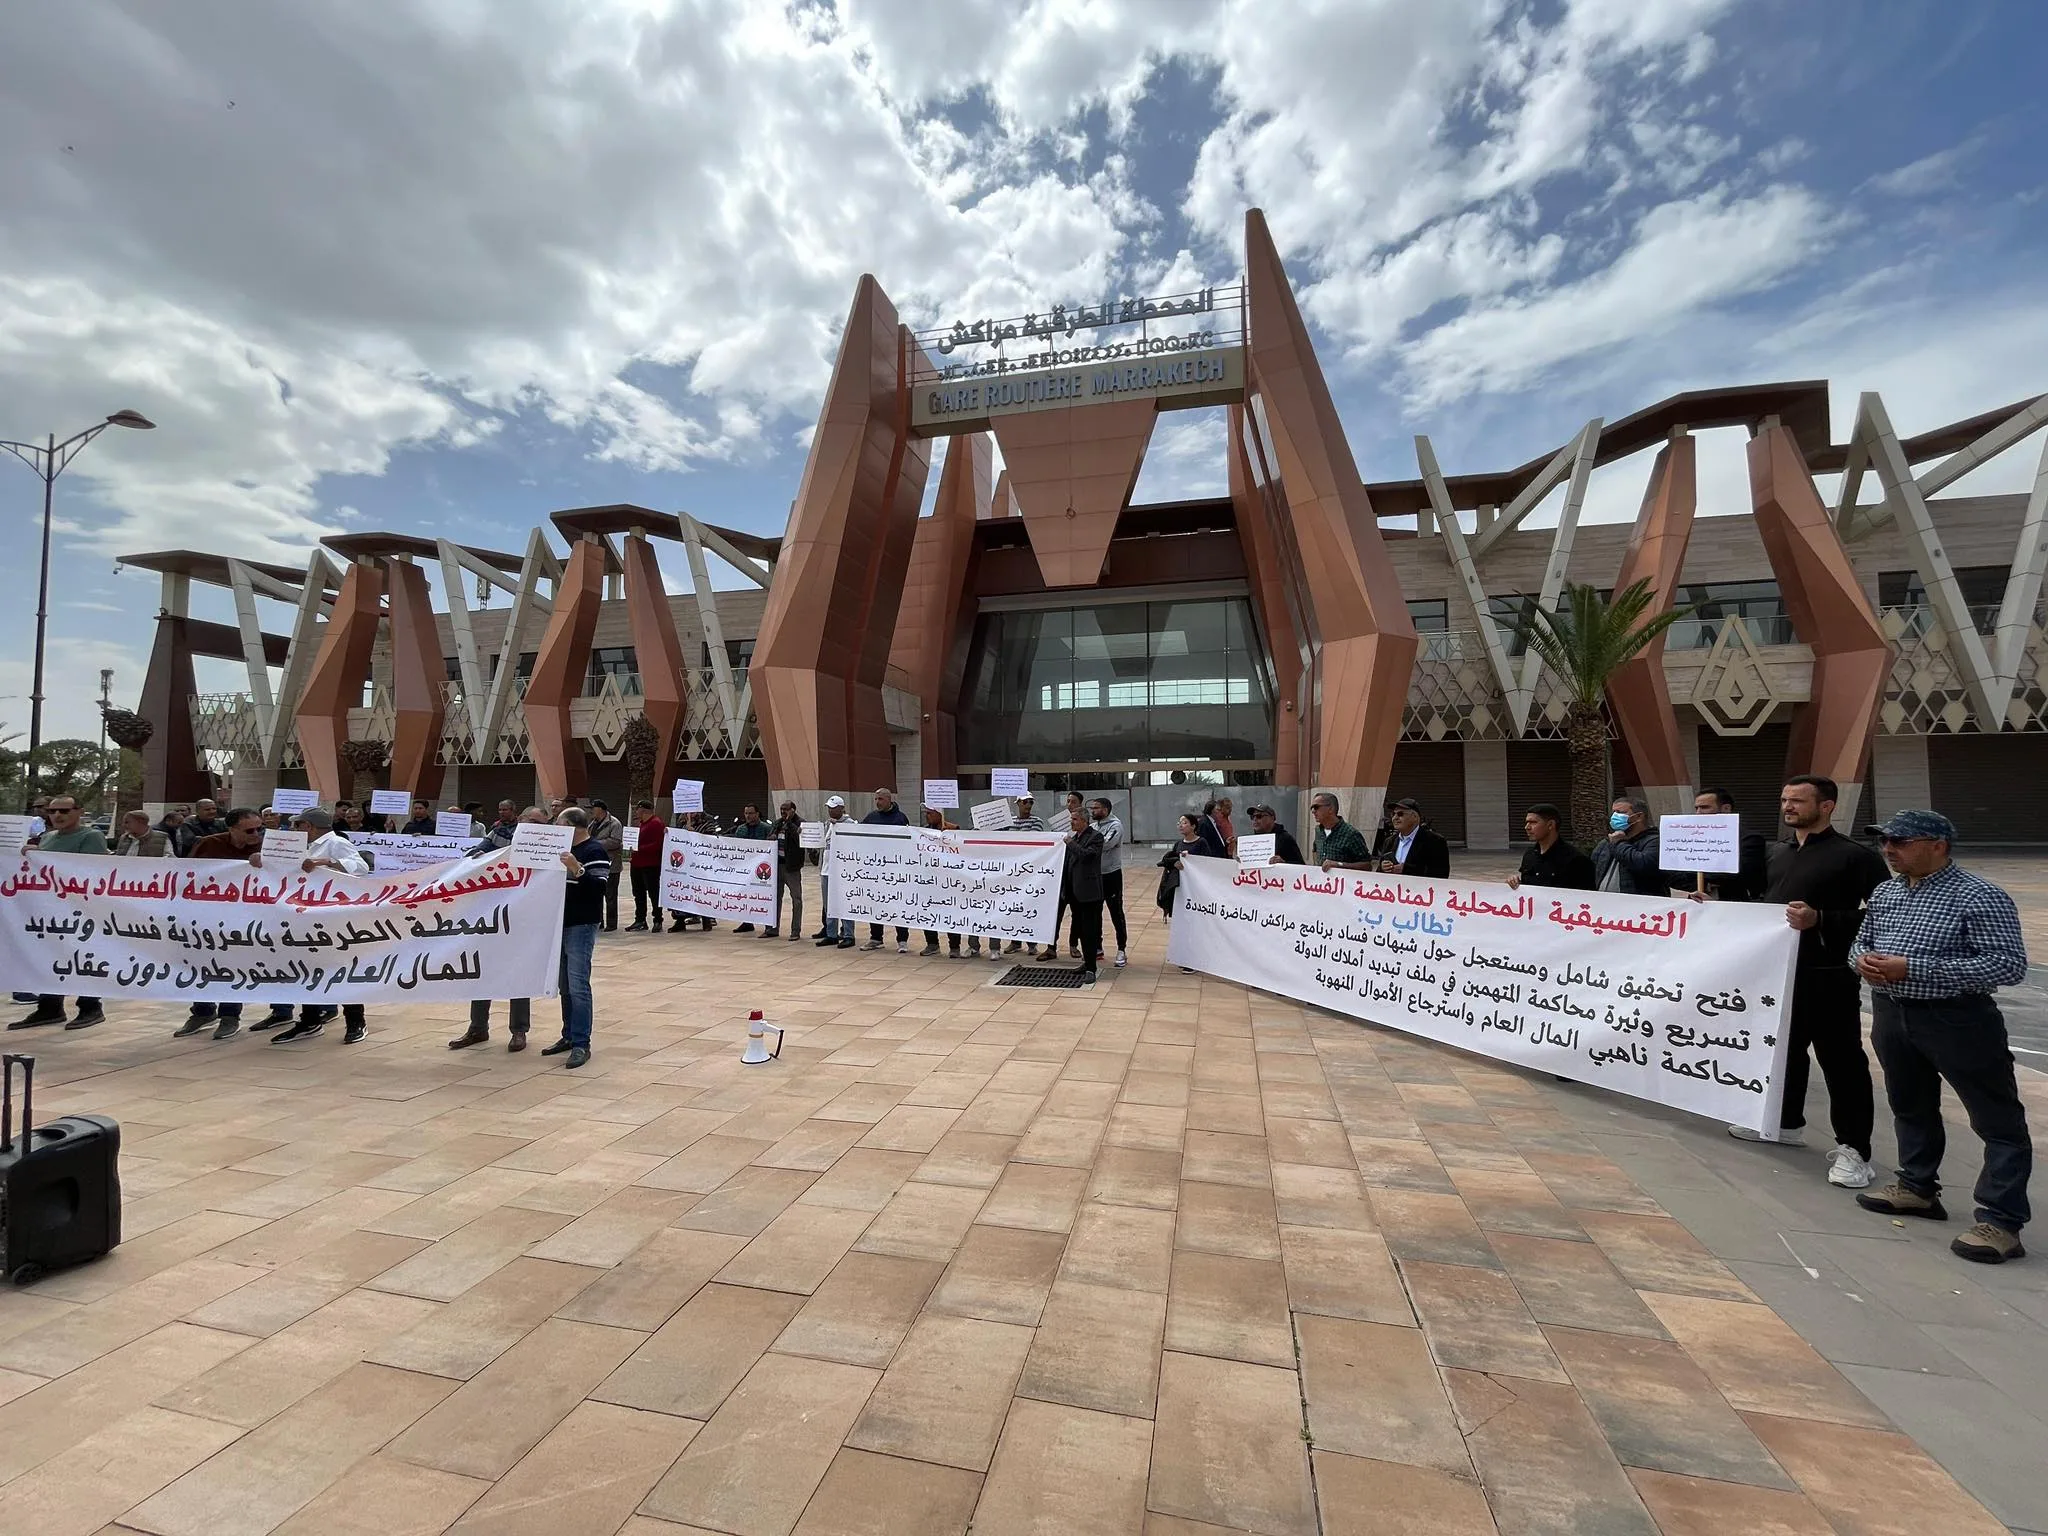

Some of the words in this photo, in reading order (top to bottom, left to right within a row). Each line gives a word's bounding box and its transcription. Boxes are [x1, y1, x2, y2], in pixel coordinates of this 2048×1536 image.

[1119, 287, 1213, 322] المحطة
[1022, 302, 1114, 342] الطرقية
[938, 319, 1017, 354] مراكش
[928, 386, 979, 414] GARE
[984, 373, 1082, 407] ROUTIÈRE
[1091, 356, 1225, 395] MARRAKECH
[836, 851, 861, 864] بالمدينة
[863, 853, 902, 866] المسؤولين
[905, 854, 922, 866] أحد
[916, 843, 960, 855] U.G.T.M
[925, 857, 940, 868] لقاء
[942, 860, 965, 869] قصد
[967, 861, 1005, 874] الطلبات
[1007, 862, 1034, 877] تكرار
[1037, 866, 1055, 877] بعد
[0, 861, 90, 901] بمراكش
[93, 868, 179, 901] الفساد
[181, 871, 288, 904] لمناهضة
[389, 862, 532, 909] التنسيقية
[667, 879, 690, 891] مراكش
[840, 869, 879, 883] يستنكرون
[881, 872, 911, 886] الطرقية
[914, 875, 938, 885] المحطة
[941, 877, 966, 892] وعمال
[969, 877, 986, 893] أطر
[1232, 868, 1285, 892] بمراكش
[1293, 873, 1345, 896] الفساد
[286, 876, 398, 913] المحلية
[846, 886, 864, 900] الذي
[866, 891, 902, 903] العزوزية
[905, 893, 918, 906] إلى
[990, 883, 1022, 895] جدوى
[1025, 884, 1046, 897] دون
[1353, 880, 1435, 908] لمناهضة
[724, 902, 748, 912] الرحيل
[848, 904, 873, 915] الحائط
[875, 909, 898, 921] عرض
[921, 896, 957, 911] التعسفي
[960, 898, 996, 914] الإنتقال
[1185, 898, 1217, 915] المتجددة
[1220, 904, 1258, 922] الحاضرة
[1446, 889, 1534, 920] المحلية
[25, 910, 96, 942] وتبديد
[103, 912, 162, 941] فساد
[404, 904, 510, 938] المحطة
[901, 911, 941, 927] الإجتماعية
[943, 915, 969, 929] الدولة
[972, 920, 998, 933] مفهوم
[1001, 924, 1035, 937] يضرب
[1261, 914, 1296, 931] مراكش
[1299, 919, 1333, 939] برنامج
[1392, 911, 1454, 937] تطالب
[1548, 901, 1688, 939] التنسيقية
[168, 915, 276, 952] بالعزوزية
[280, 918, 402, 953] الطرقية
[1338, 925, 1368, 943] فساد
[1373, 932, 1417, 955] شبهات
[1294, 940, 1327, 959] الدولة
[1331, 948, 1364, 968] أملاك
[1423, 939, 1456, 961] حول
[52, 949, 110, 982] عقاب
[117, 956, 171, 987] دون
[175, 957, 324, 991] والمتورطون
[324, 953, 399, 994] العام
[397, 950, 481, 990] للمال
[1368, 959, 1401, 979] تبديد
[1406, 964, 1436, 984] ملف
[1462, 947, 1549, 981] ومستعجل
[1556, 962, 1610, 989] شامل
[1315, 968, 1354, 992] المنهوبة
[1359, 980, 1403, 1003] الأموال
[1442, 970, 1457, 997] في
[1462, 980, 1521, 1003] المتهمين
[1617, 975, 1684, 1003] تحقيق
[1408, 991, 1475, 1026] واسترجاع
[1528, 988, 1596, 1021] محاكمة
[1695, 988, 1747, 1017] فتح
[1481, 1010, 1525, 1035] العام
[1604, 1005, 1654, 1037] وثيرة
[1530, 1021, 1579, 1050] المال
[1665, 1023, 1750, 1051] تسريع
[1588, 1043, 1648, 1067] ناهبي
[1661, 1051, 1764, 1095] محاكمة
